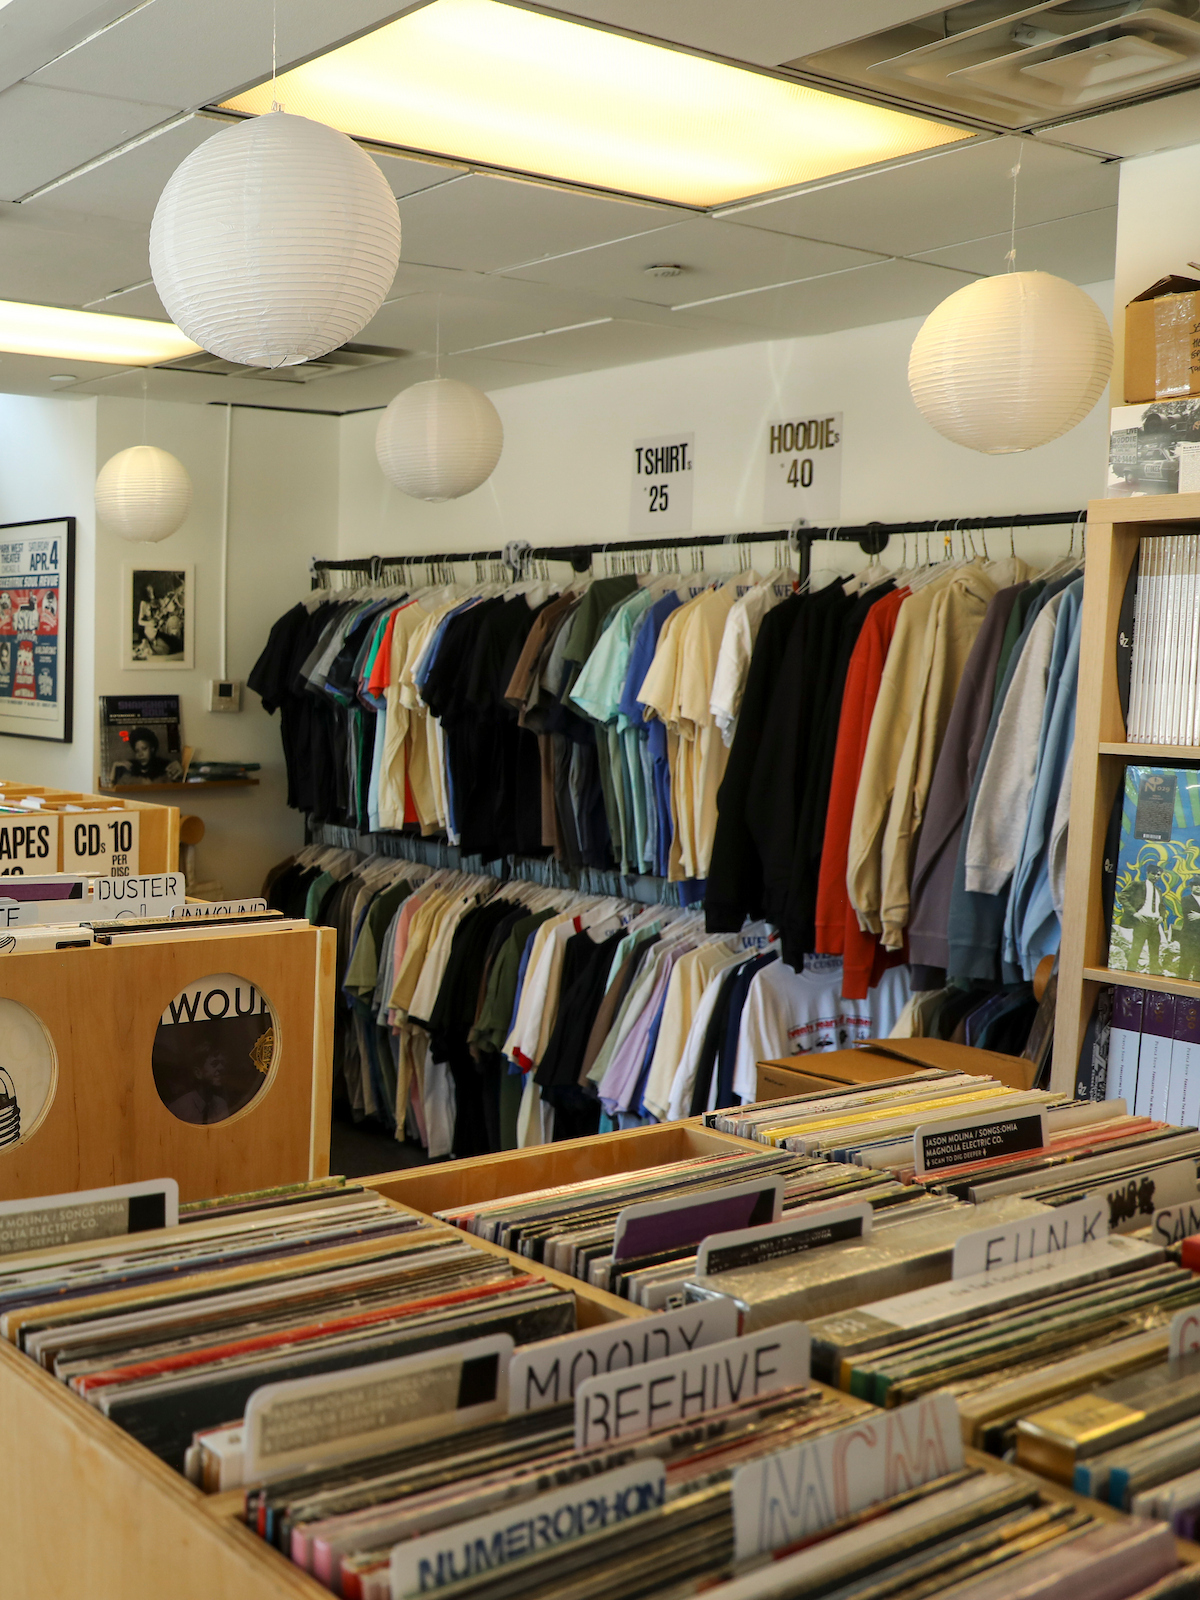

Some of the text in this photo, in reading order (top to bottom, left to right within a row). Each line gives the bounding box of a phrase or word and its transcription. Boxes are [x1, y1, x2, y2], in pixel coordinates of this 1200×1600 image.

[49, 540, 58, 570] 4
[112, 854, 128, 866] PER
[111, 867, 130, 877] DISC
[99, 877, 177, 900] DUSTER
[162, 985, 267, 1024] WOU
[925, 1137, 947, 1148] JASON
[948, 1132, 974, 1143] MOLINA
[925, 1135, 1004, 1157] MAGNOLIA ELECTRIC CO.
[946, 1155, 953, 1163] TO
[964, 1150, 982, 1160] DEEPER
[6, 1214, 49, 1228] MOLINA
[29, 1219, 78, 1236] ELECTRIC
[81, 1217, 99, 1230] CO.
[583, 1343, 781, 1448] BEEHIVE
[418, 1477, 667, 1592] NUMEROPHON
